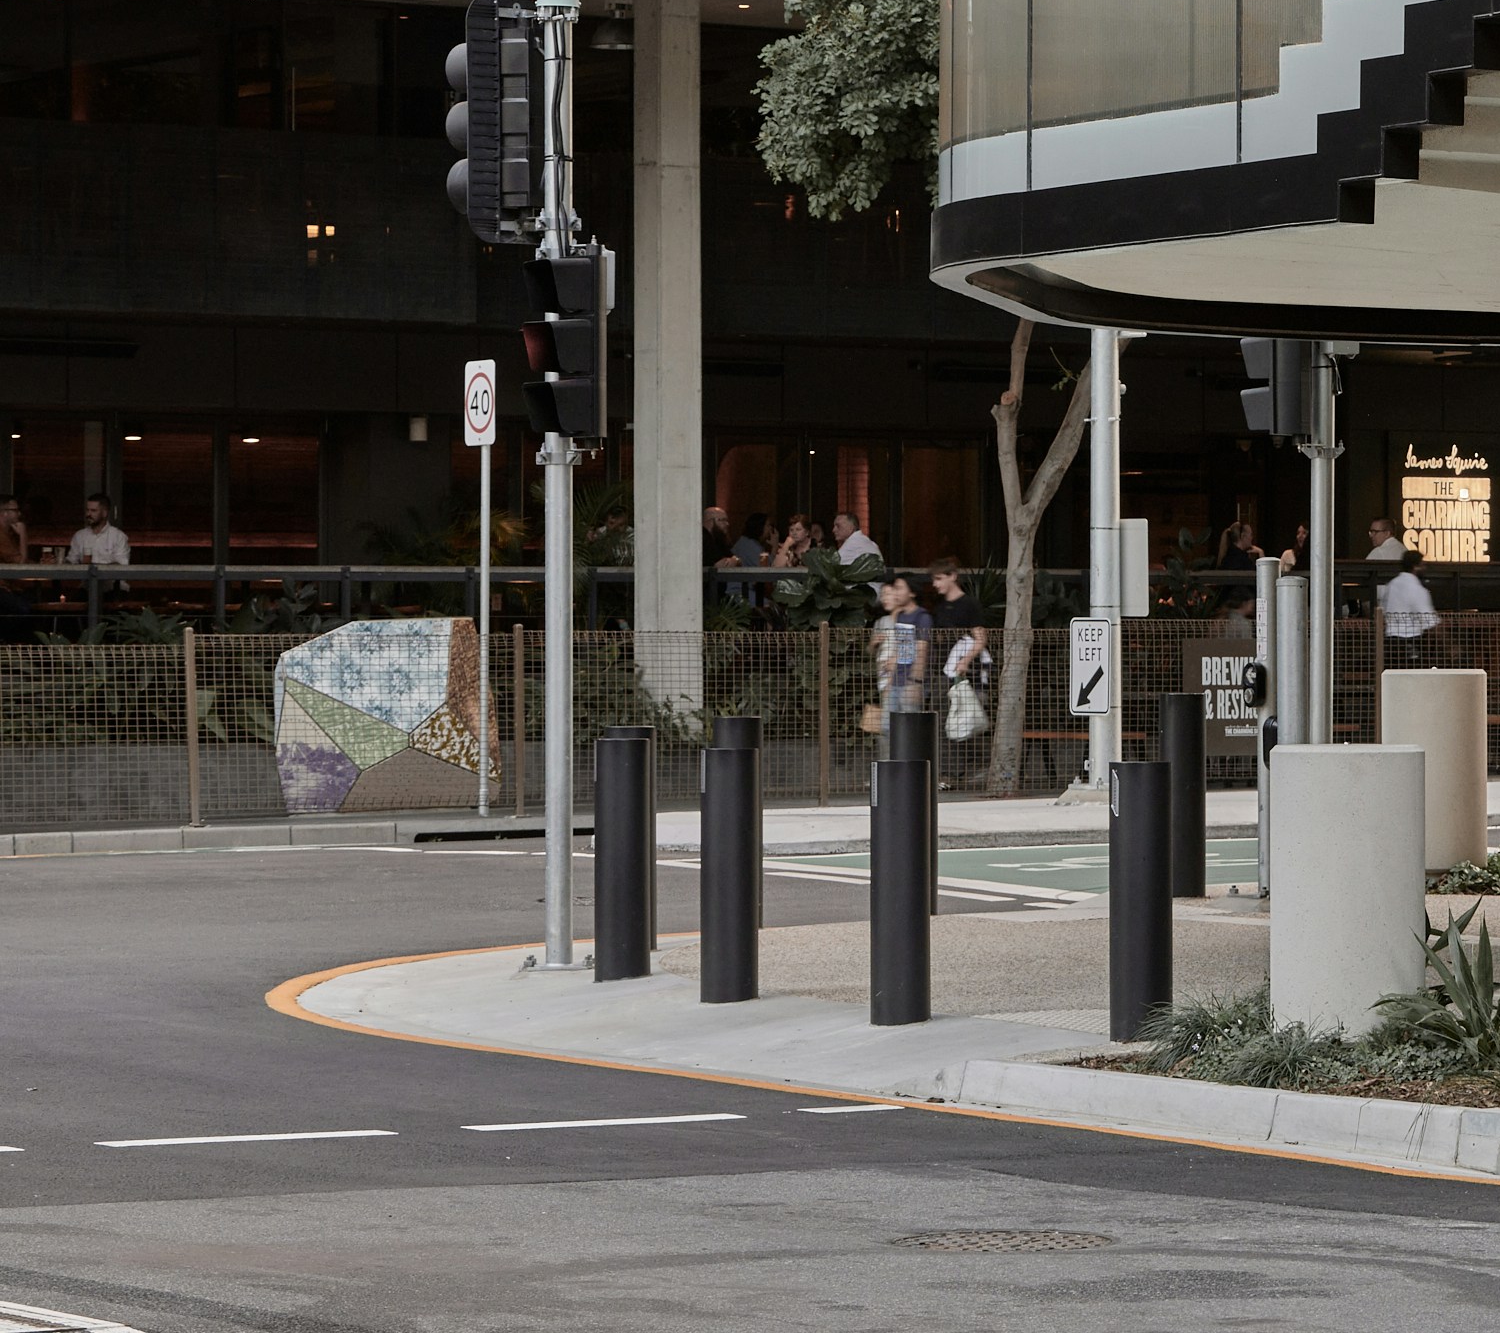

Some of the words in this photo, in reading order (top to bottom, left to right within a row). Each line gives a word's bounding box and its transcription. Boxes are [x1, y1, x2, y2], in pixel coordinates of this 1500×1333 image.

[470, 389, 490, 416] 40
[1405, 443, 1443, 470] James
[1445, 443, 1488, 475] Squire
[1433, 481, 1454, 495] THE
[1402, 500, 1490, 529] CHARMING
[1402, 529, 1490, 562] SQUIRE
[1078, 628, 1103, 642] KEEP
[1078, 647, 1102, 661] LEFT
[1201, 656, 1254, 686] BREW
[1204, 689, 1214, 720] &
[1216, 689, 1258, 719] REST
